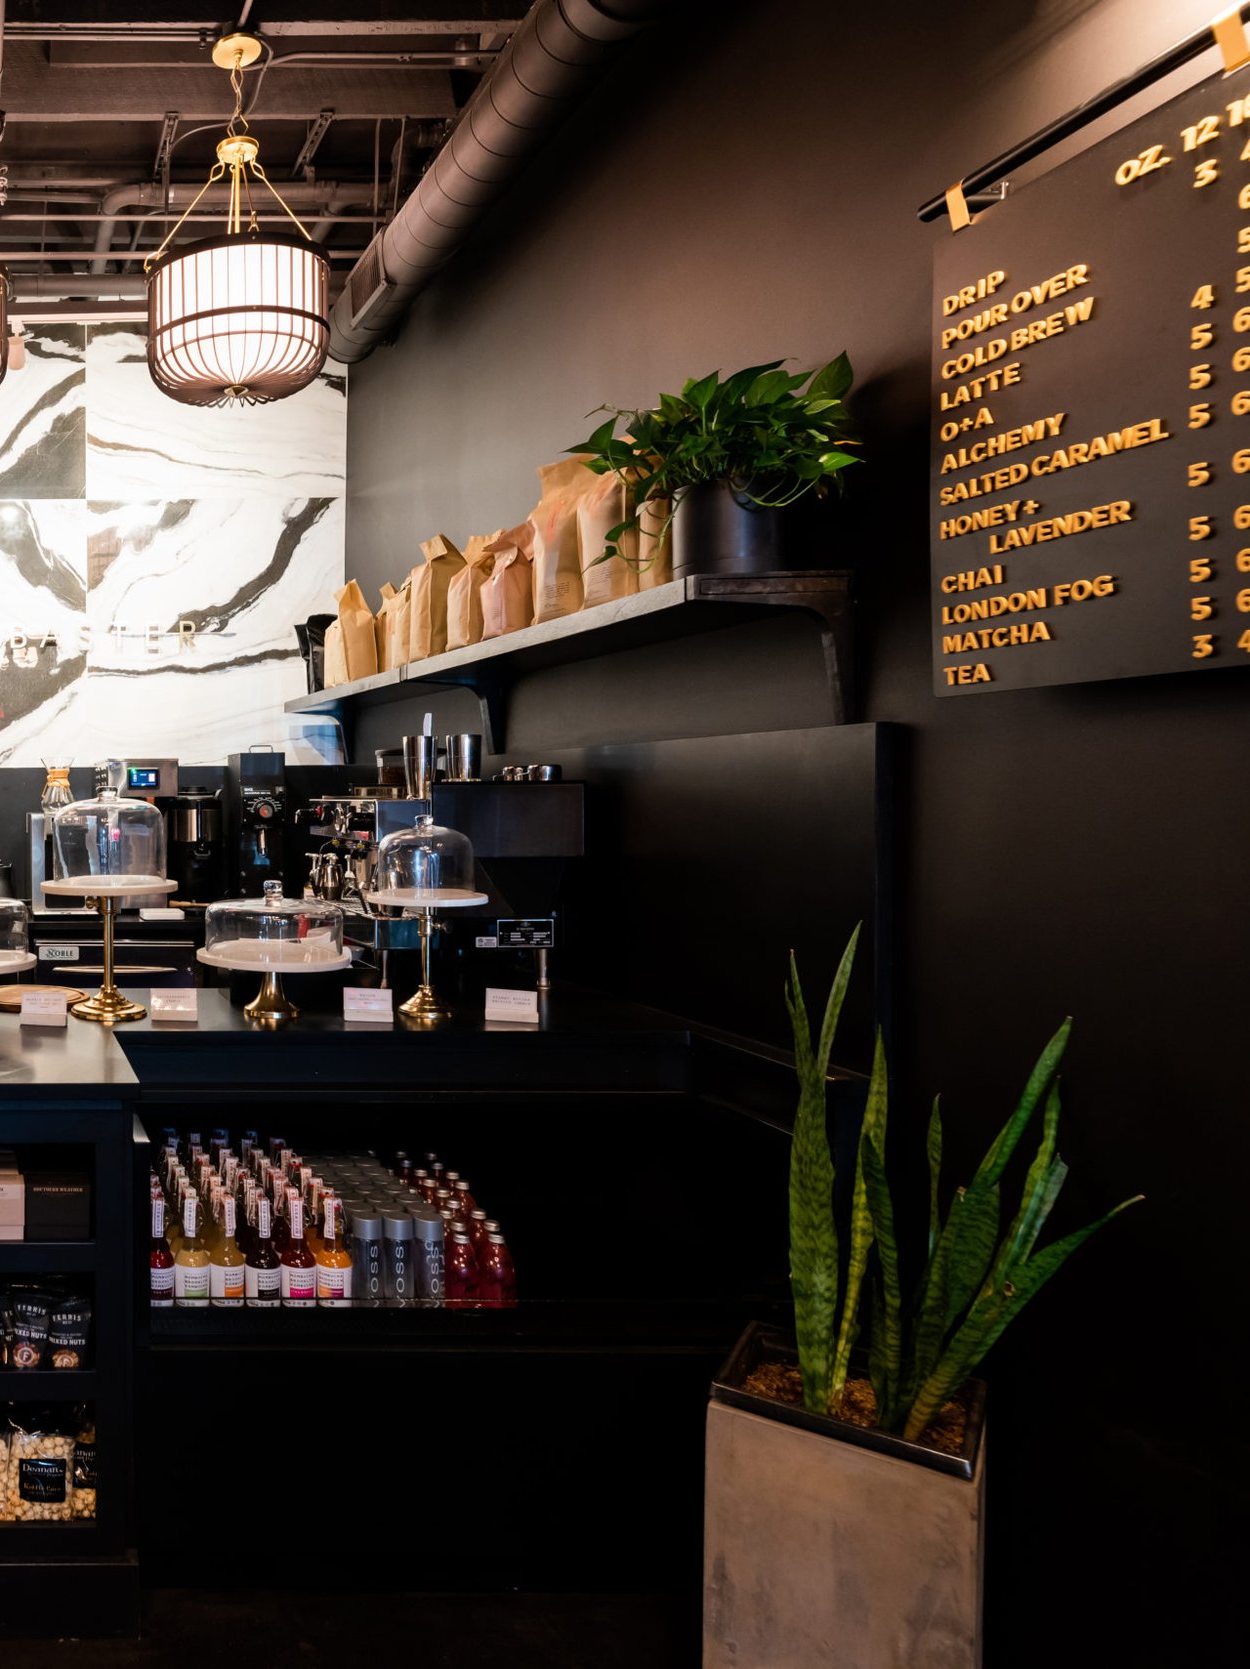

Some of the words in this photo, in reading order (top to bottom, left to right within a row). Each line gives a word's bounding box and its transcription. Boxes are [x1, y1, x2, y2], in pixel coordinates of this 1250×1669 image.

[1115, 145, 1172, 185] OZ.
[1180, 115, 1221, 152] 12
[943, 270, 1006, 317] DRIP
[1193, 159, 1218, 188] 3
[940, 362, 1021, 411] LATTE
[1190, 285, 1214, 309] 4
[941, 339, 1007, 379] COLD
[1011, 297, 1094, 351] BREW
[942, 303, 1008, 349] POUR
[1011, 264, 1090, 313] OVER
[940, 407, 994, 442] O+A
[1190, 323, 1213, 350] 5
[1232, 306, 1250, 332] 6
[940, 413, 1067, 474] ALCHEMY
[1188, 363, 1212, 390] 5
[1232, 347, 1250, 372] 6
[939, 463, 1029, 505] SALTED
[1031, 418, 1169, 476] CARAMEL
[1188, 403, 1211, 429] 5
[1231, 390, 1250, 415] 6
[939, 500, 1020, 540] HONEY
[1023, 500, 1039, 514] +
[1187, 462, 1210, 487] 5
[1231, 448, 1250, 474] 6
[989, 500, 1132, 554] LAVENDER
[941, 564, 1004, 593] CHAI
[1188, 516, 1211, 541] 5
[1233, 504, 1250, 529] 6
[942, 588, 1046, 624] LONDON
[1053, 575, 1115, 605] FOG
[1189, 558, 1211, 583] 5
[942, 621, 1050, 654] MATCHA
[1191, 596, 1212, 620] 5
[943, 663, 991, 685] TEA
[1192, 634, 1213, 658] 3
[395, 1246, 405, 1308] VOSS
[31, 1331, 47, 1339] NUTS
